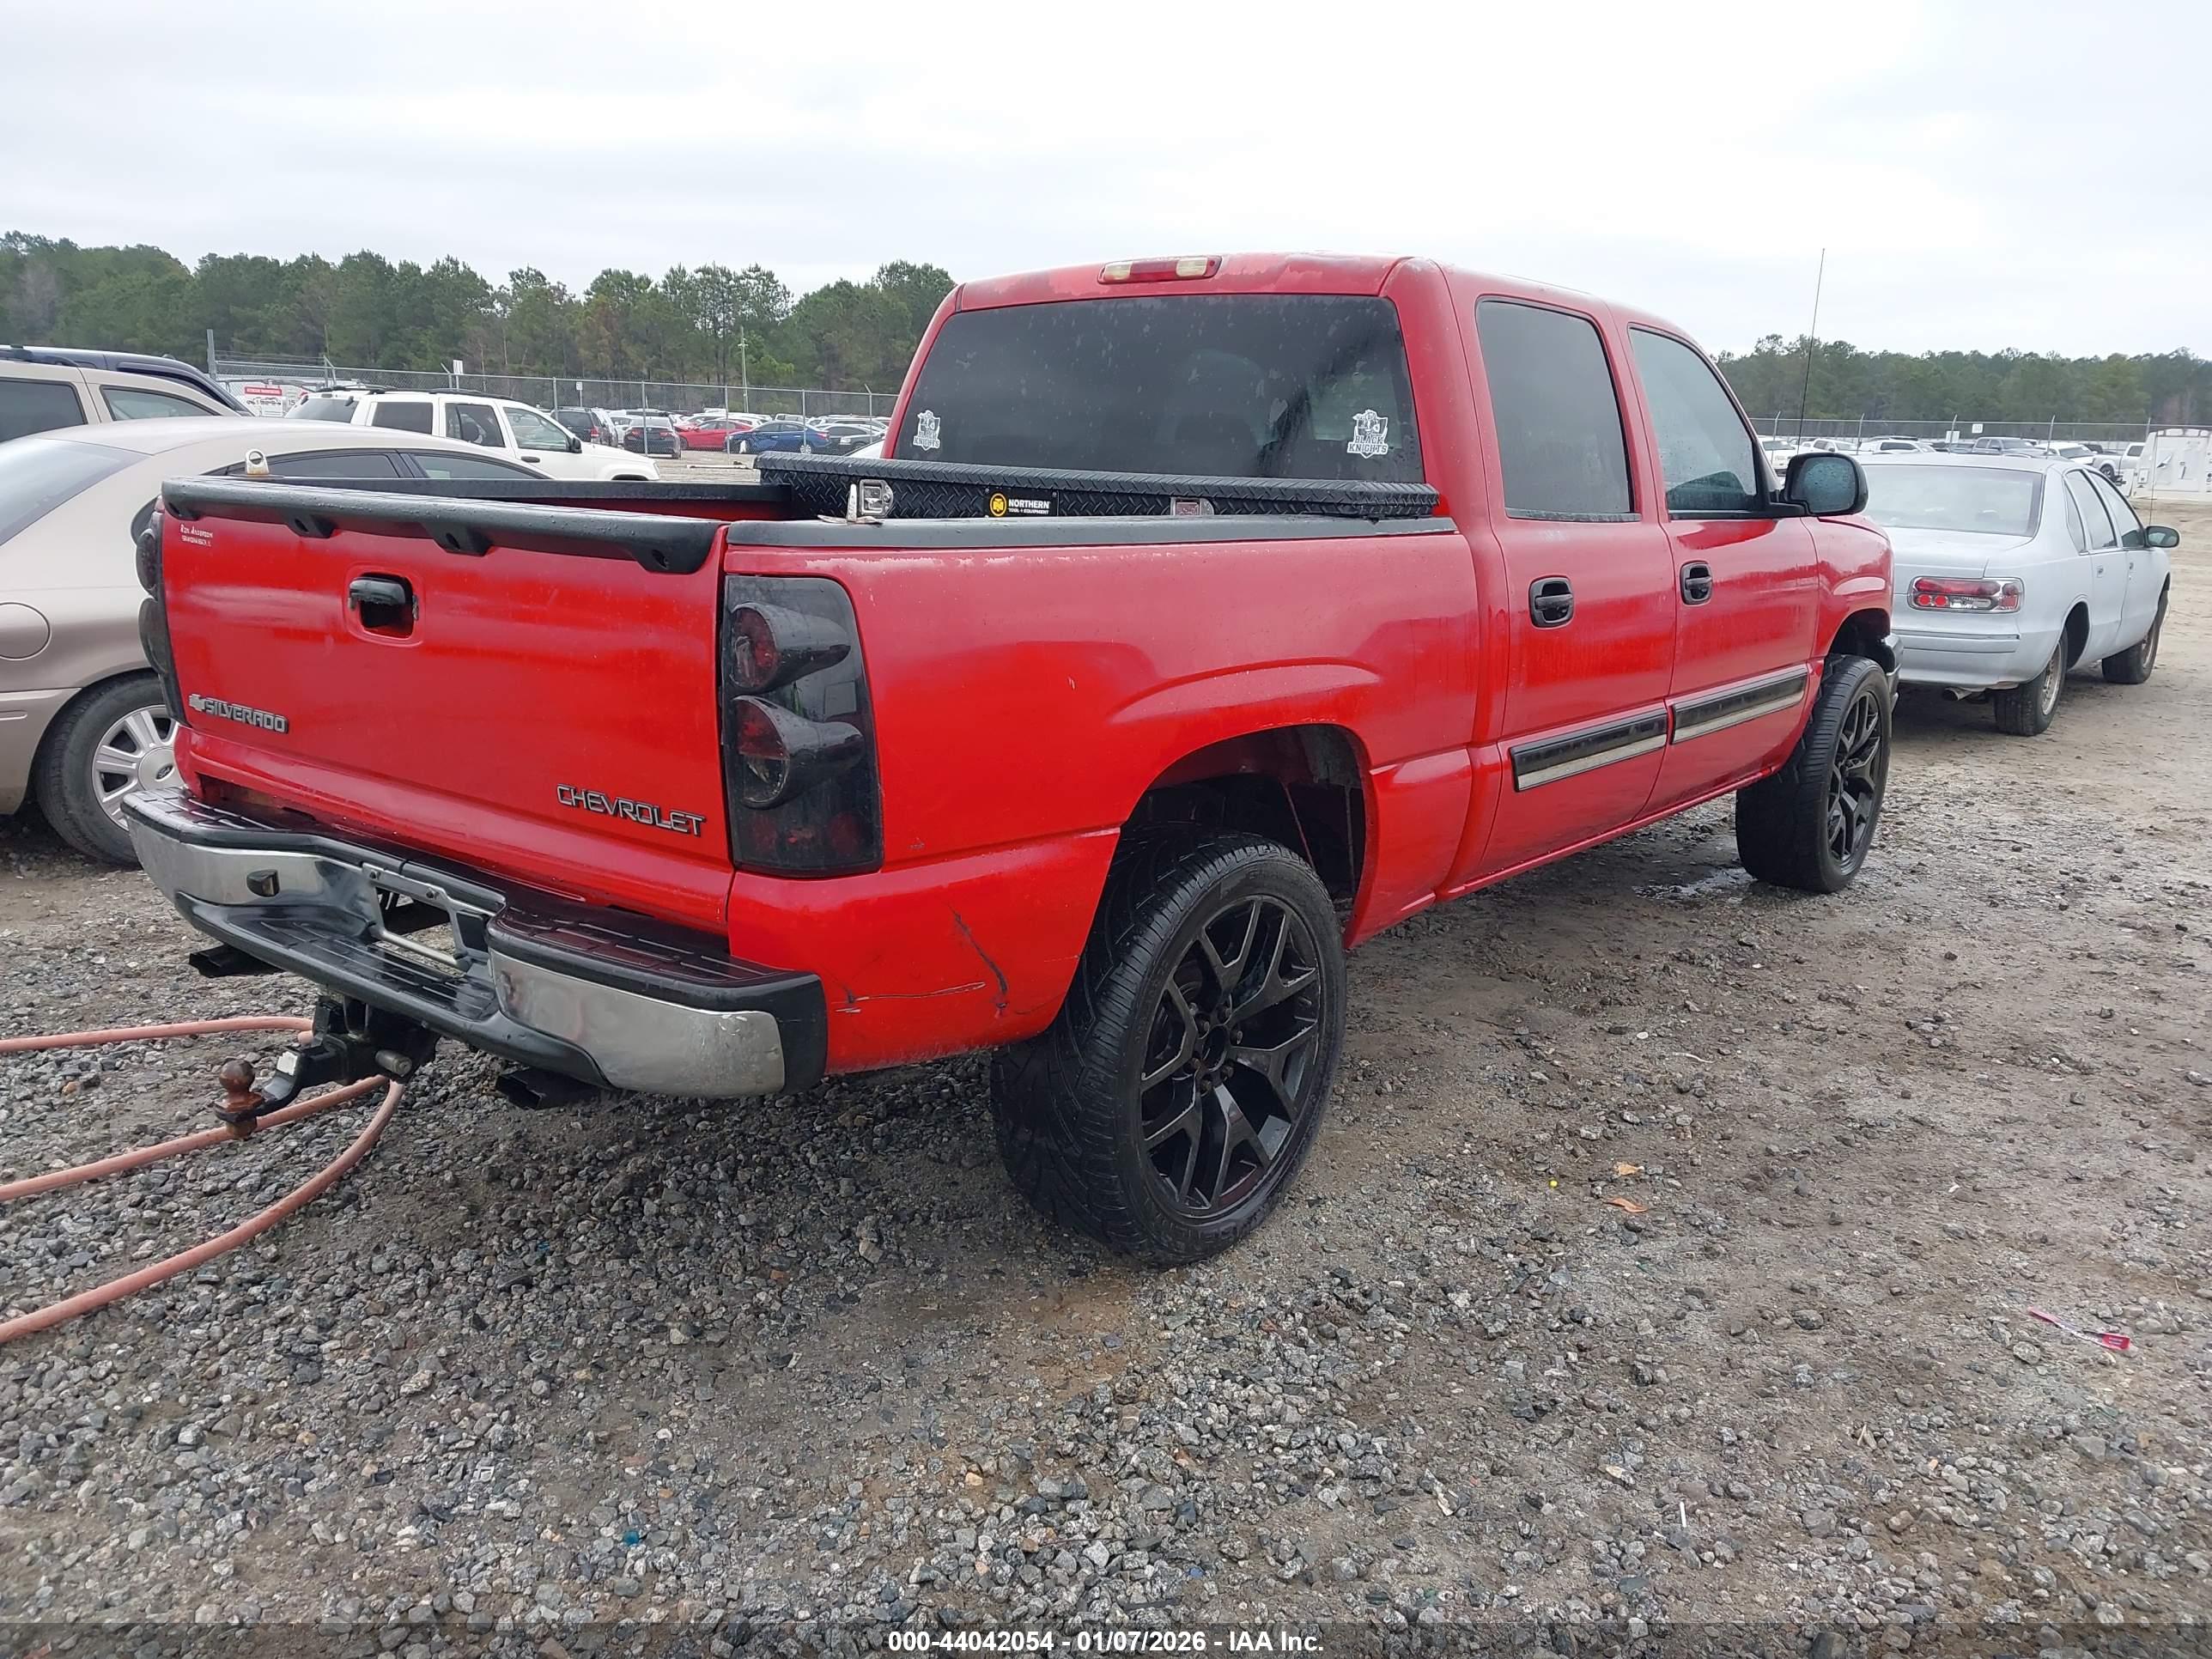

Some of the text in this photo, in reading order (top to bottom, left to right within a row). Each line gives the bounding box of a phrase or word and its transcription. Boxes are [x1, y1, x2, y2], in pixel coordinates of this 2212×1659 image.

[913, 436, 940, 447] KNIGHTS
[1355, 435, 1384, 445] BLACK
[1347, 442, 1388, 454] KNIGHTS
[1008, 499, 1049, 508] NORTHERN
[204, 697, 289, 734] SILVERADO
[557, 783, 705, 837] CHEVROLET
